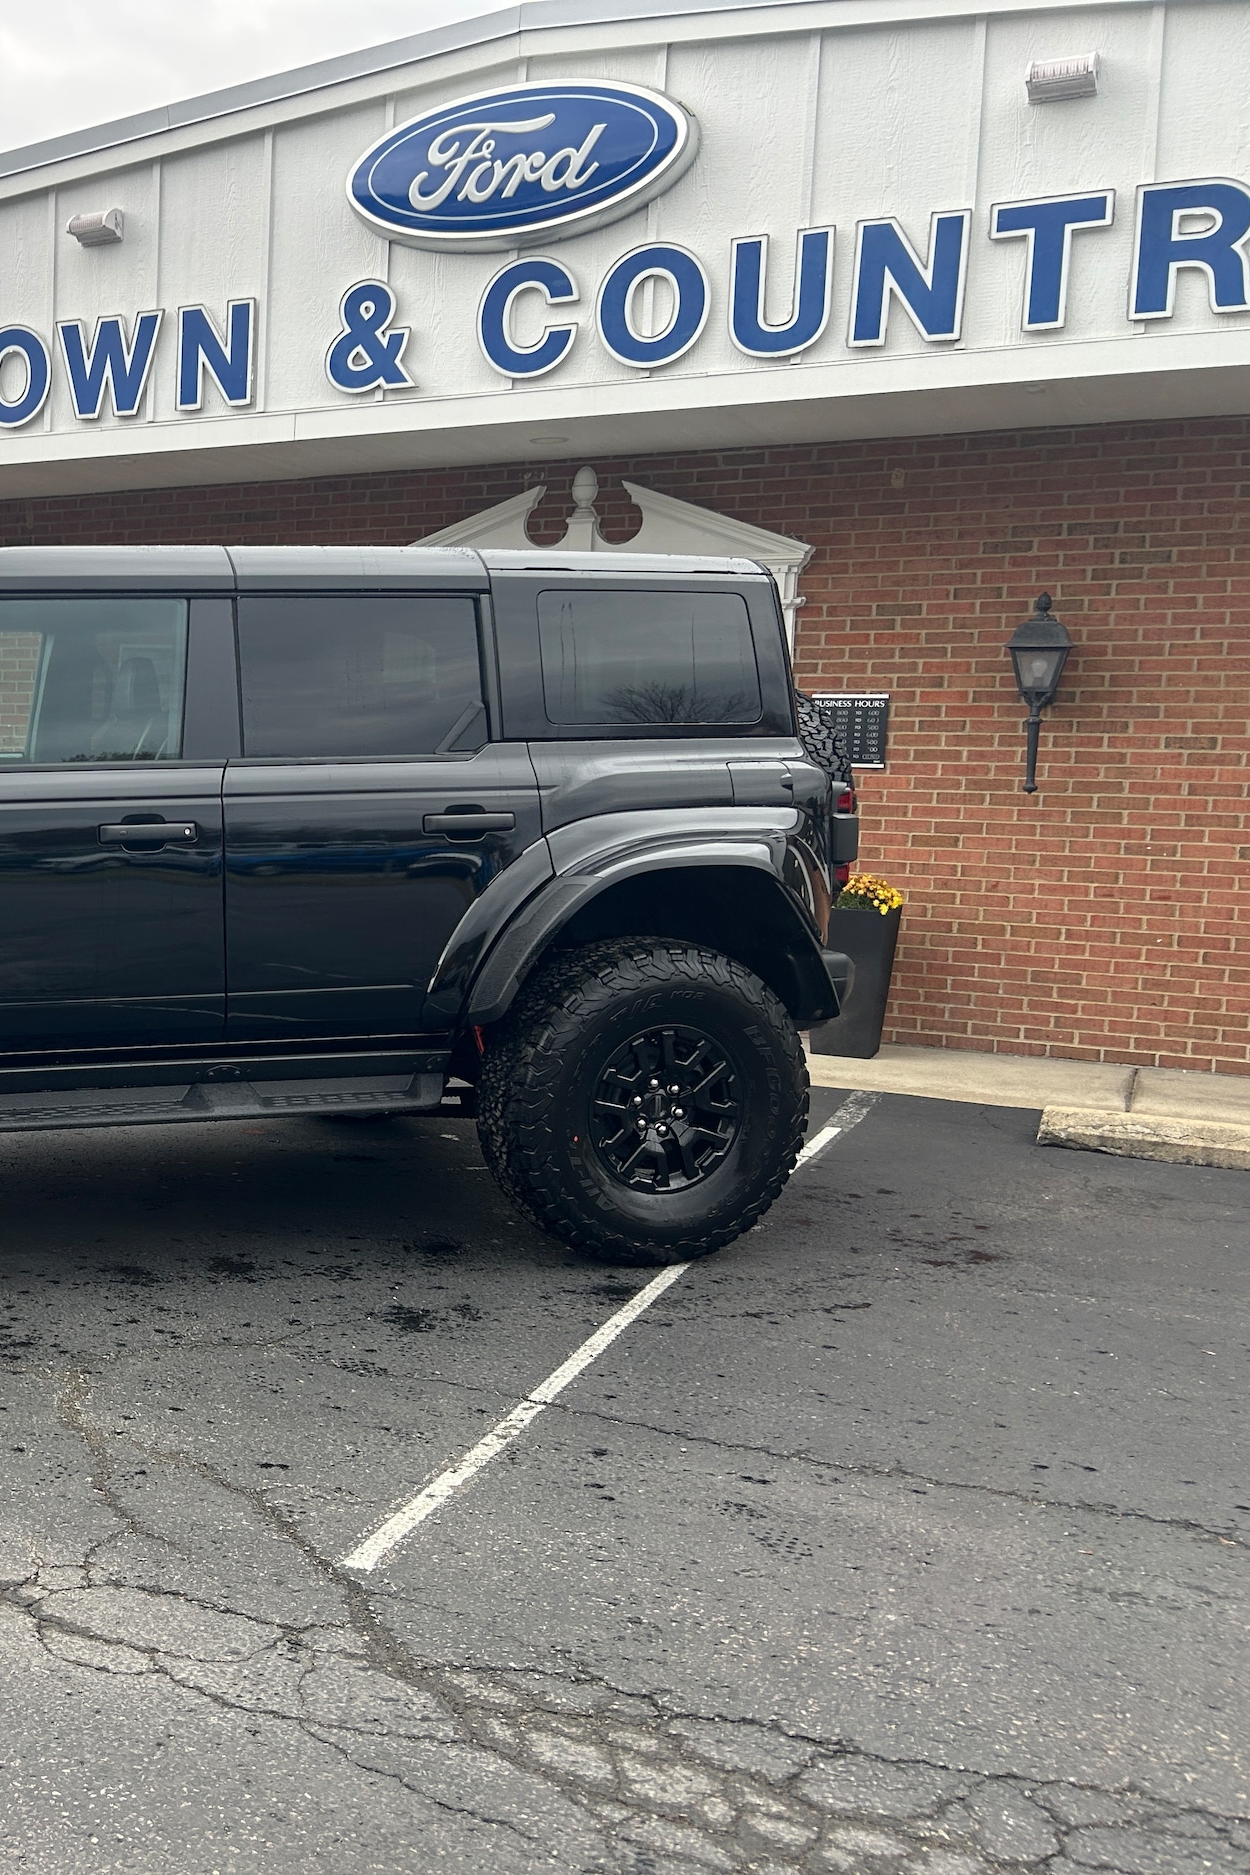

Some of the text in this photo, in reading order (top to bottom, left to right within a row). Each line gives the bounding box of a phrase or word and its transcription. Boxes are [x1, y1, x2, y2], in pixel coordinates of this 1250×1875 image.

[407, 112, 607, 213] Ford
[325, 278, 418, 395] &
[477, 176, 1250, 379] COUNTR
[854, 700, 885, 708] HOURS
